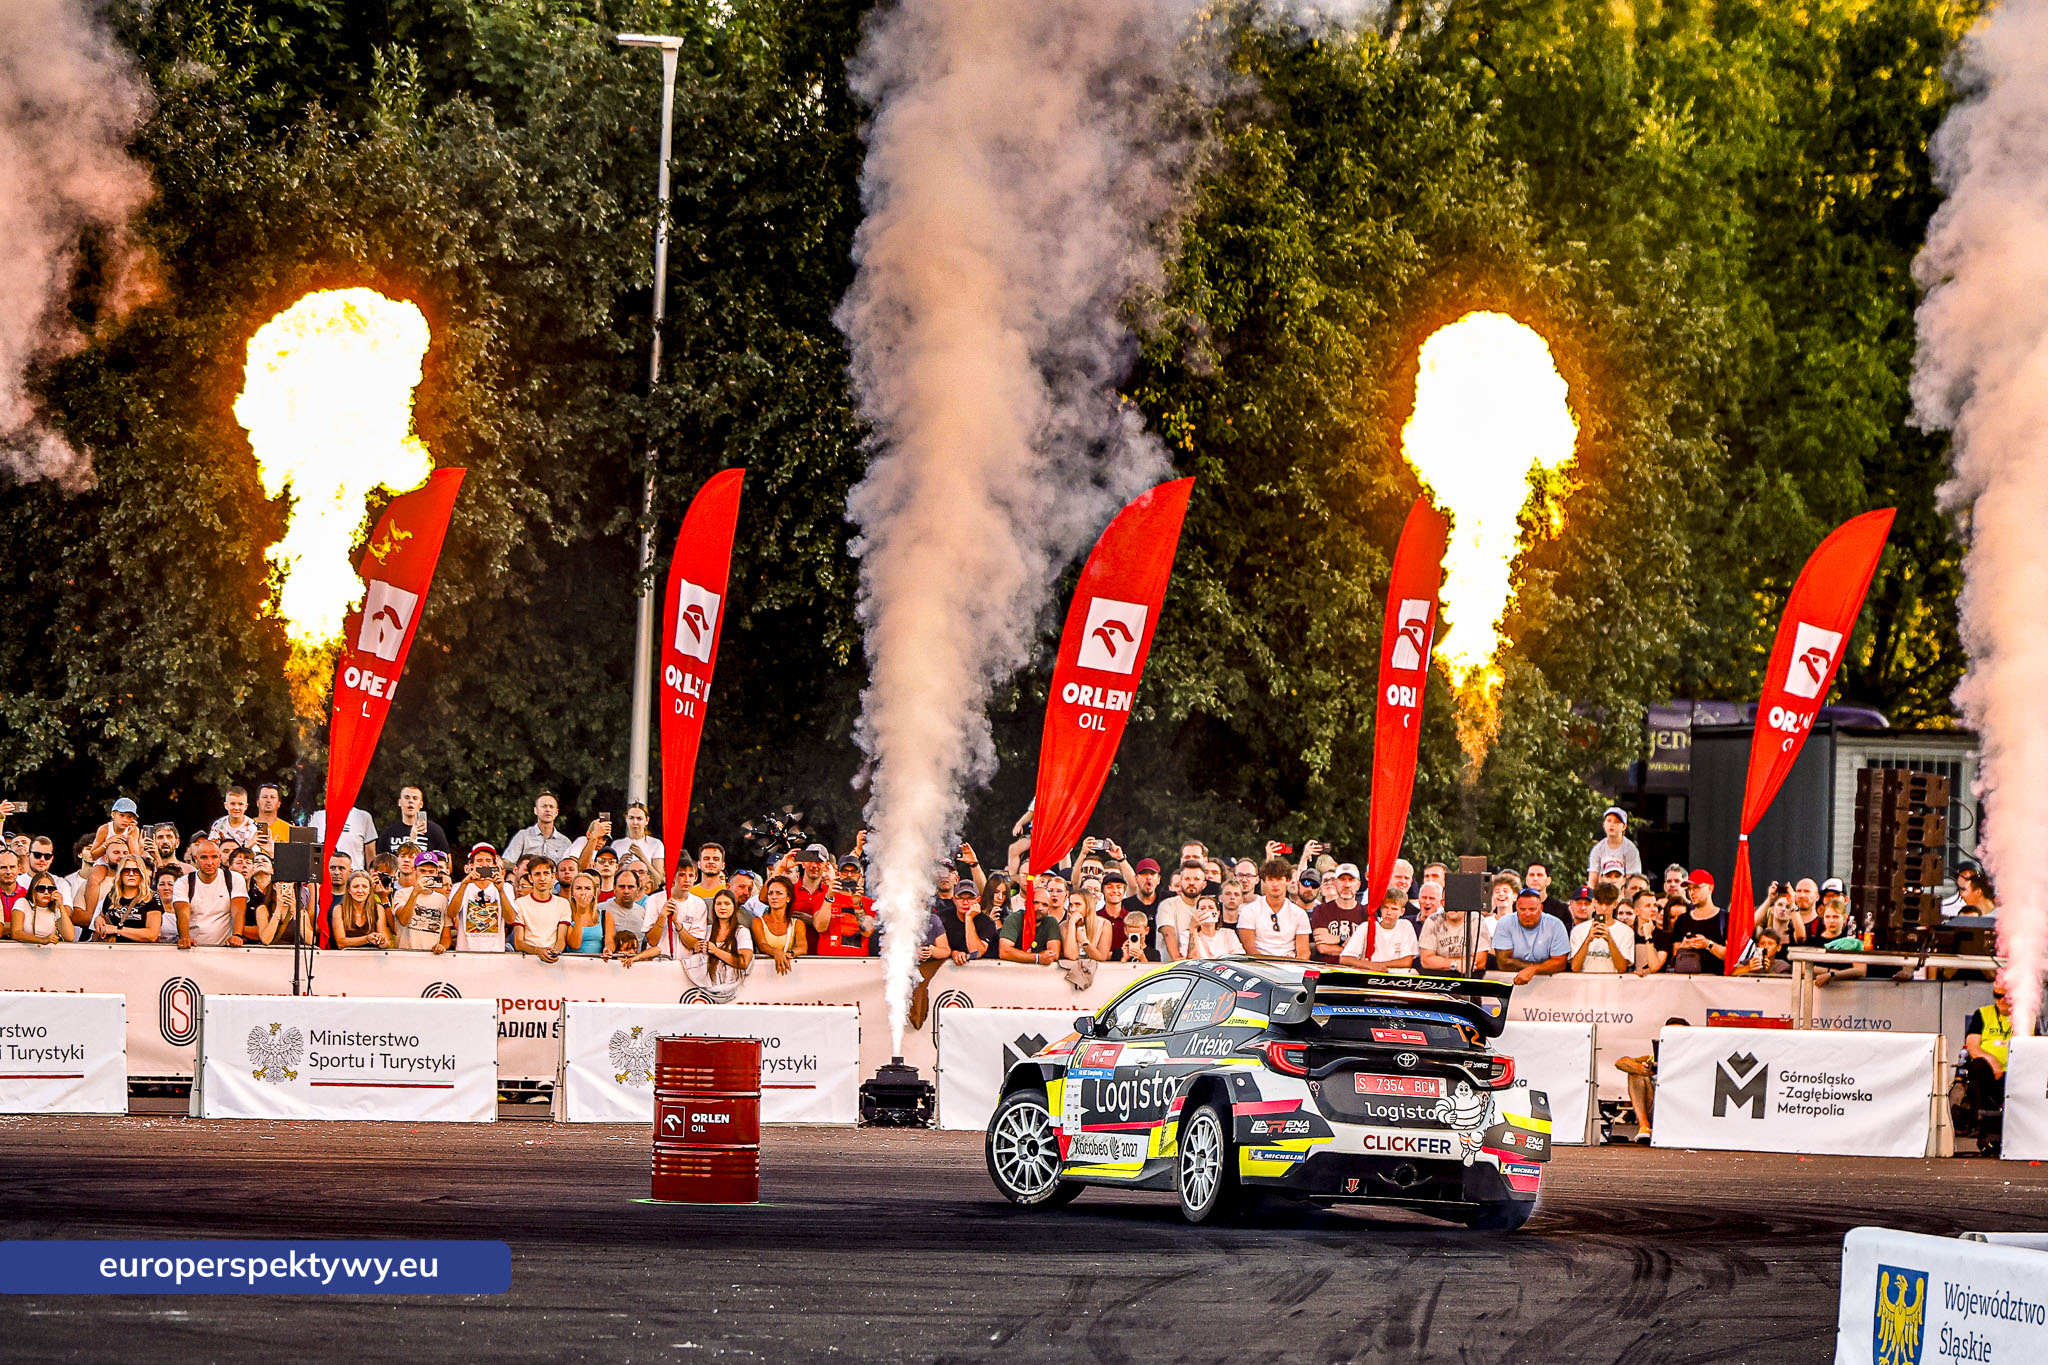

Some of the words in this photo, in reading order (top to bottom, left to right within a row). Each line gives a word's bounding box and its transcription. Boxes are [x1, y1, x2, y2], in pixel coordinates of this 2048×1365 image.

[1062, 682, 1133, 711] ORLEN
[1078, 712, 1106, 731] OIL
[1211, 991, 1236, 1023] 12
[0, 1024, 47, 1038] rstwo
[310, 1029, 419, 1047] Ministerstwo
[1452, 1023, 1485, 1047] 12
[7, 1044, 85, 1063] Turystyki
[1182, 1032, 1234, 1056] Arteixo
[309, 1052, 365, 1070] Sportu
[370, 1053, 374, 1068] i
[379, 1053, 456, 1072] Turystyki
[1359, 1078, 1367, 1090] S
[1377, 1078, 1404, 1092] 7354
[1415, 1081, 1436, 1095] BCM
[1779, 1070, 1855, 1088] Górnośląsko
[691, 1113, 730, 1123] ORLEN
[1365, 1102, 1437, 1122] logista
[1777, 1102, 1845, 1118] Metropolia
[691, 1124, 706, 1132] OIL
[1122, 1142, 1138, 1158] 2027
[1363, 1135, 1452, 1155] CLICKFER
[1264, 1152, 1304, 1160] MICHELIN
[1512, 1166, 1540, 1175] MICHELIN
[1944, 1281, 2046, 1326] Województwo
[1939, 1321, 1992, 1365] Śląskie
